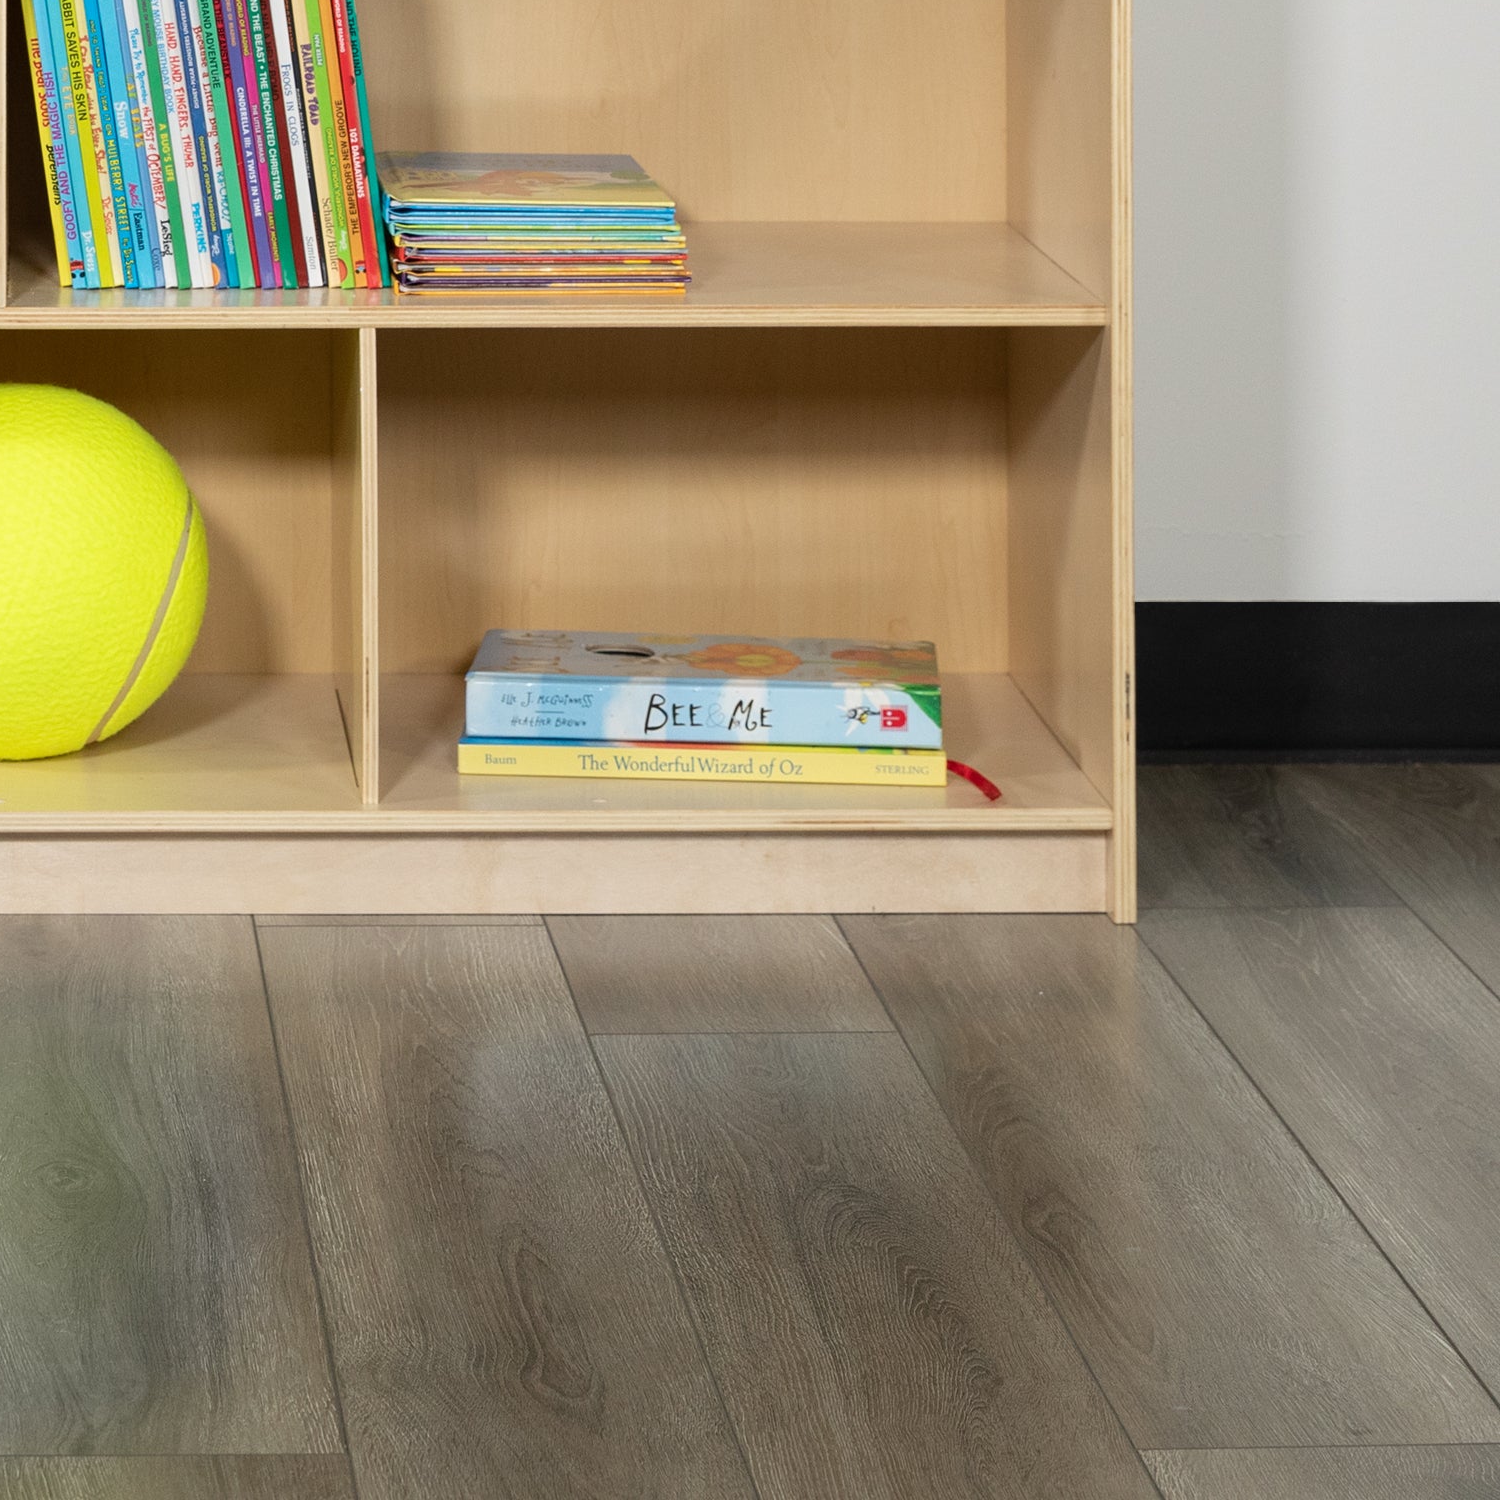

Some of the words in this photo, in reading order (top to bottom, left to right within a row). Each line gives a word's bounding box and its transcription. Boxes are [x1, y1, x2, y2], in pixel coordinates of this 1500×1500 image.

[152, 9, 164, 40] MOUSE
[178, 0, 188, 34] UNIVERSITY
[237, 19, 245, 27] OF
[251, 14, 261, 31] THE
[66, 31, 80, 68] SAVES
[239, 28, 249, 56] READING
[253, 33, 265, 62] BEAST
[337, 28, 345, 52] READING
[157, 43, 171, 86] BIRTHDAY
[204, 31, 220, 88] ADVENTURE
[299, 43, 317, 94] RAILROAD
[42, 72, 55, 97] FISH
[72, 72, 83, 90] HIS
[258, 71, 268, 89] THE
[280, 64, 293, 96] FROGS
[75, 93, 87, 120] SKIN
[164, 88, 174, 113] BOOK
[236, 87, 249, 134] CINDERELLA
[285, 101, 294, 111] IN
[307, 96, 320, 125] TOAD
[47, 101, 61, 139] MAGIC
[113, 101, 132, 138] Snow
[142, 118, 155, 141] FIRST
[252, 116, 261, 132] LITTLE
[260, 91, 275, 145] ENCHANTED
[287, 116, 299, 146] CLOGS
[334, 100, 346, 137] GROOVE
[160, 133, 171, 162] BUG'S
[197, 135, 207, 162] READING
[255, 134, 265, 163] MERMAID
[348, 128, 357, 143] 102
[53, 144, 65, 166] THE
[180, 135, 195, 168] THUMB
[339, 140, 349, 160] NEW
[146, 153, 167, 209] OCTEMBER!
[165, 164, 174, 181] LIFE
[201, 163, 208, 172] OF
[246, 158, 256, 183] TWIST
[268, 148, 282, 200] CHRISTMAS
[351, 145, 365, 198] DALMATIANS
[57, 171, 70, 194] AND
[106, 139, 122, 190] MULBERRY
[114, 196, 129, 231] STREET
[202, 173, 211, 193] WORLD
[250, 185, 258, 195] IN
[342, 163, 356, 215] EMPEROR'S
[62, 199, 77, 240] GOOFY
[206, 195, 216, 231] WONDERFUL
[252, 198, 261, 216] TIME
[82, 230, 93, 244] Dr.
[133, 212, 147, 250] Eastman
[156, 219, 174, 256] LeSieg
[190, 202, 206, 253] PERKINS
[350, 218, 359, 234] THE
[84, 246, 97, 271] Seuss
[644, 694, 703, 734] BEE
[728, 699, 773, 732] ME
[484, 754, 517, 765] Baum
[578, 754, 609, 771] The
[614, 756, 695, 773] Wonderful
[697, 757, 754, 774] Wizard
[759, 760, 774, 777] of
[779, 760, 803, 776] Oz
[876, 765, 930, 775] STERLING
